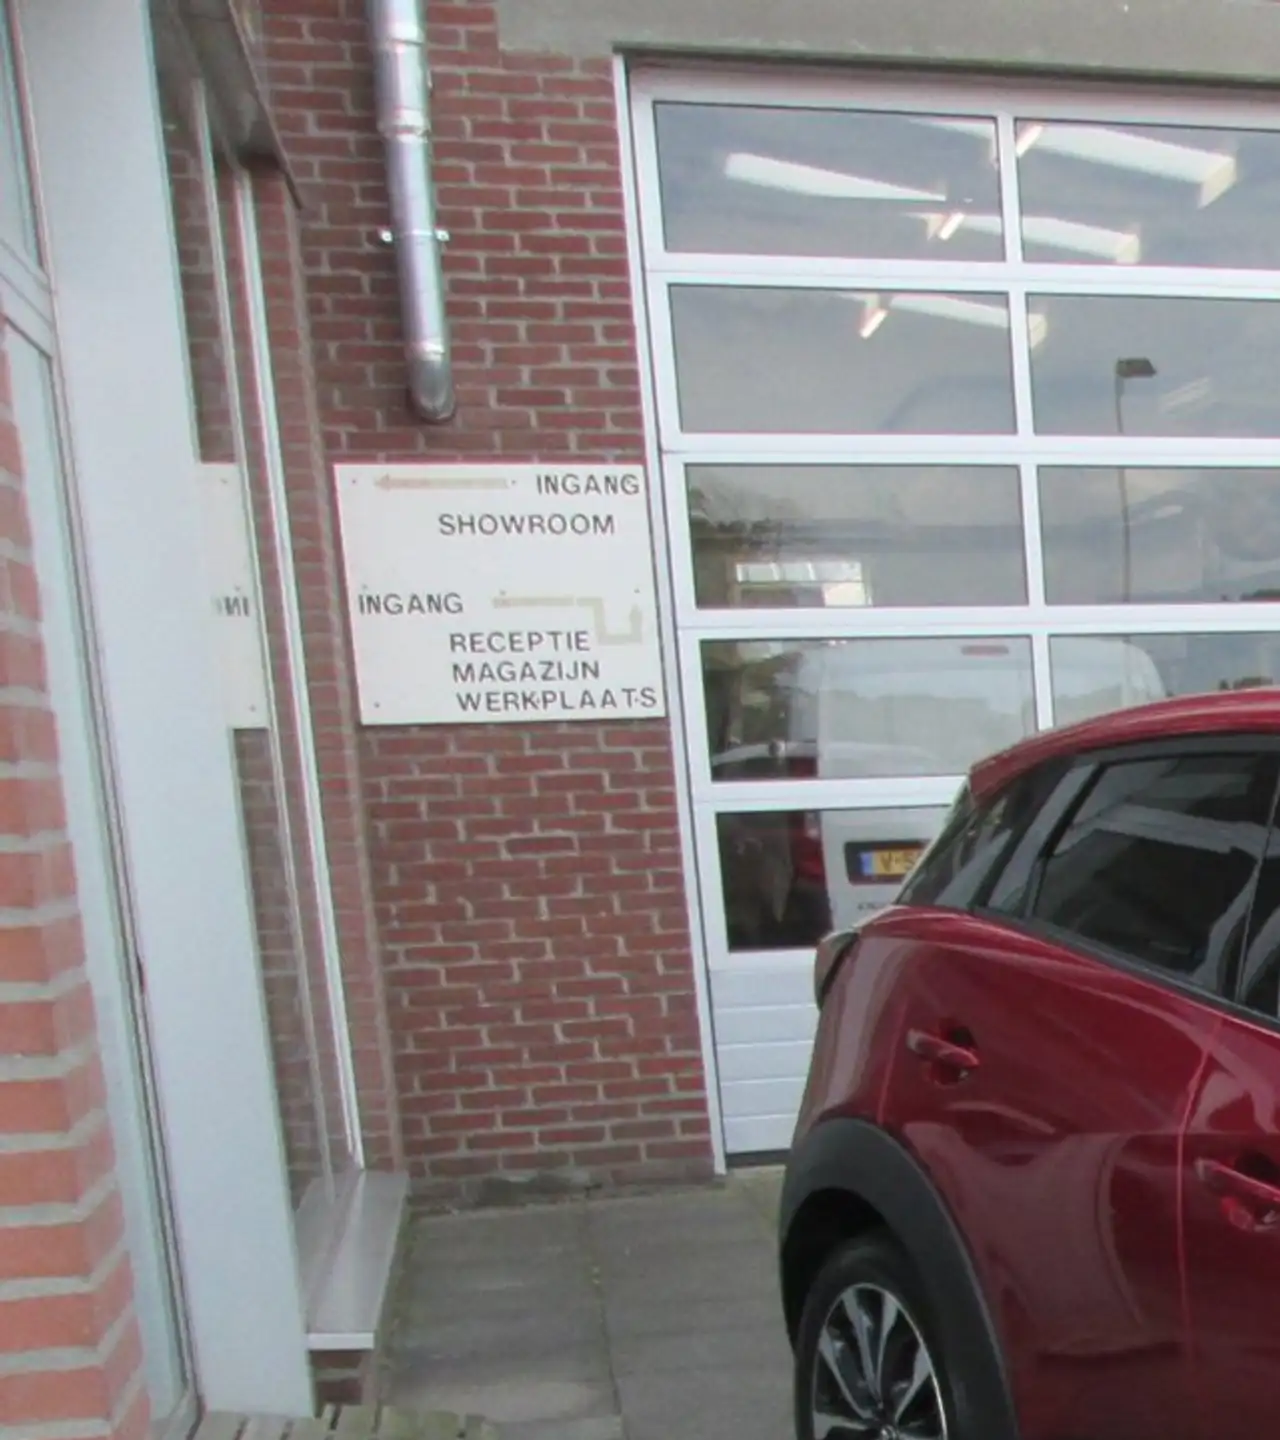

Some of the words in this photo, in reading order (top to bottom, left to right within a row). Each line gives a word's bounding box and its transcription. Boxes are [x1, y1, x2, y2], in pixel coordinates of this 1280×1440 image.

[535, 473, 641, 496] INGANG
[438, 513, 615, 536] SHOWROOM
[358, 592, 464, 616] INGANG
[449, 630, 591, 654] RECEPTIE
[452, 660, 600, 683] MAGAZIJN
[456, 687, 657, 712] WERKPLAATS
